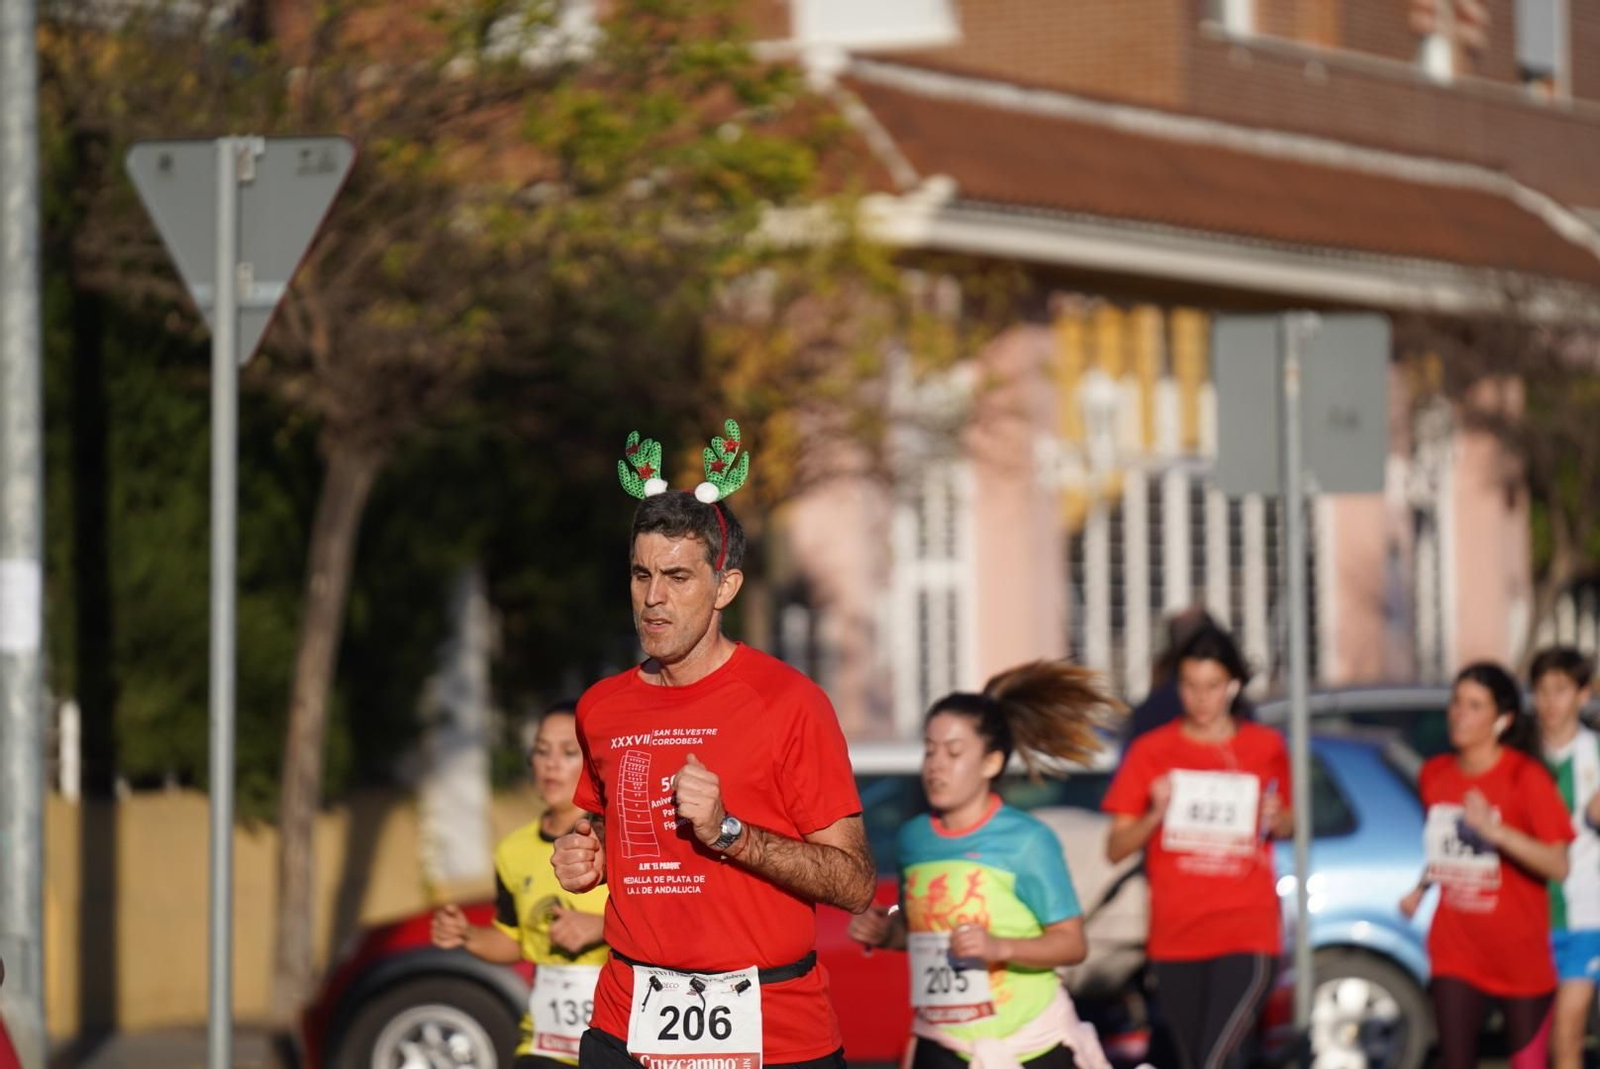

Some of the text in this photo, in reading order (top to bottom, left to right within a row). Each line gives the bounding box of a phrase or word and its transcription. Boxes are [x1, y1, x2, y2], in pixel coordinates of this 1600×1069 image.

[654, 728, 718, 737] SAN SILVESTRE
[610, 734, 650, 749] XXXVII
[652, 737, 704, 746] CORDOBESA
[653, 875, 665, 883] DE
[666, 875, 692, 883] PLATA
[693, 875, 706, 883] DE
[641, 886, 653, 894] DE
[654, 886, 701, 894] ANDALUCIA
[924, 966, 969, 994] 205
[657, 1005, 732, 1041] 206
